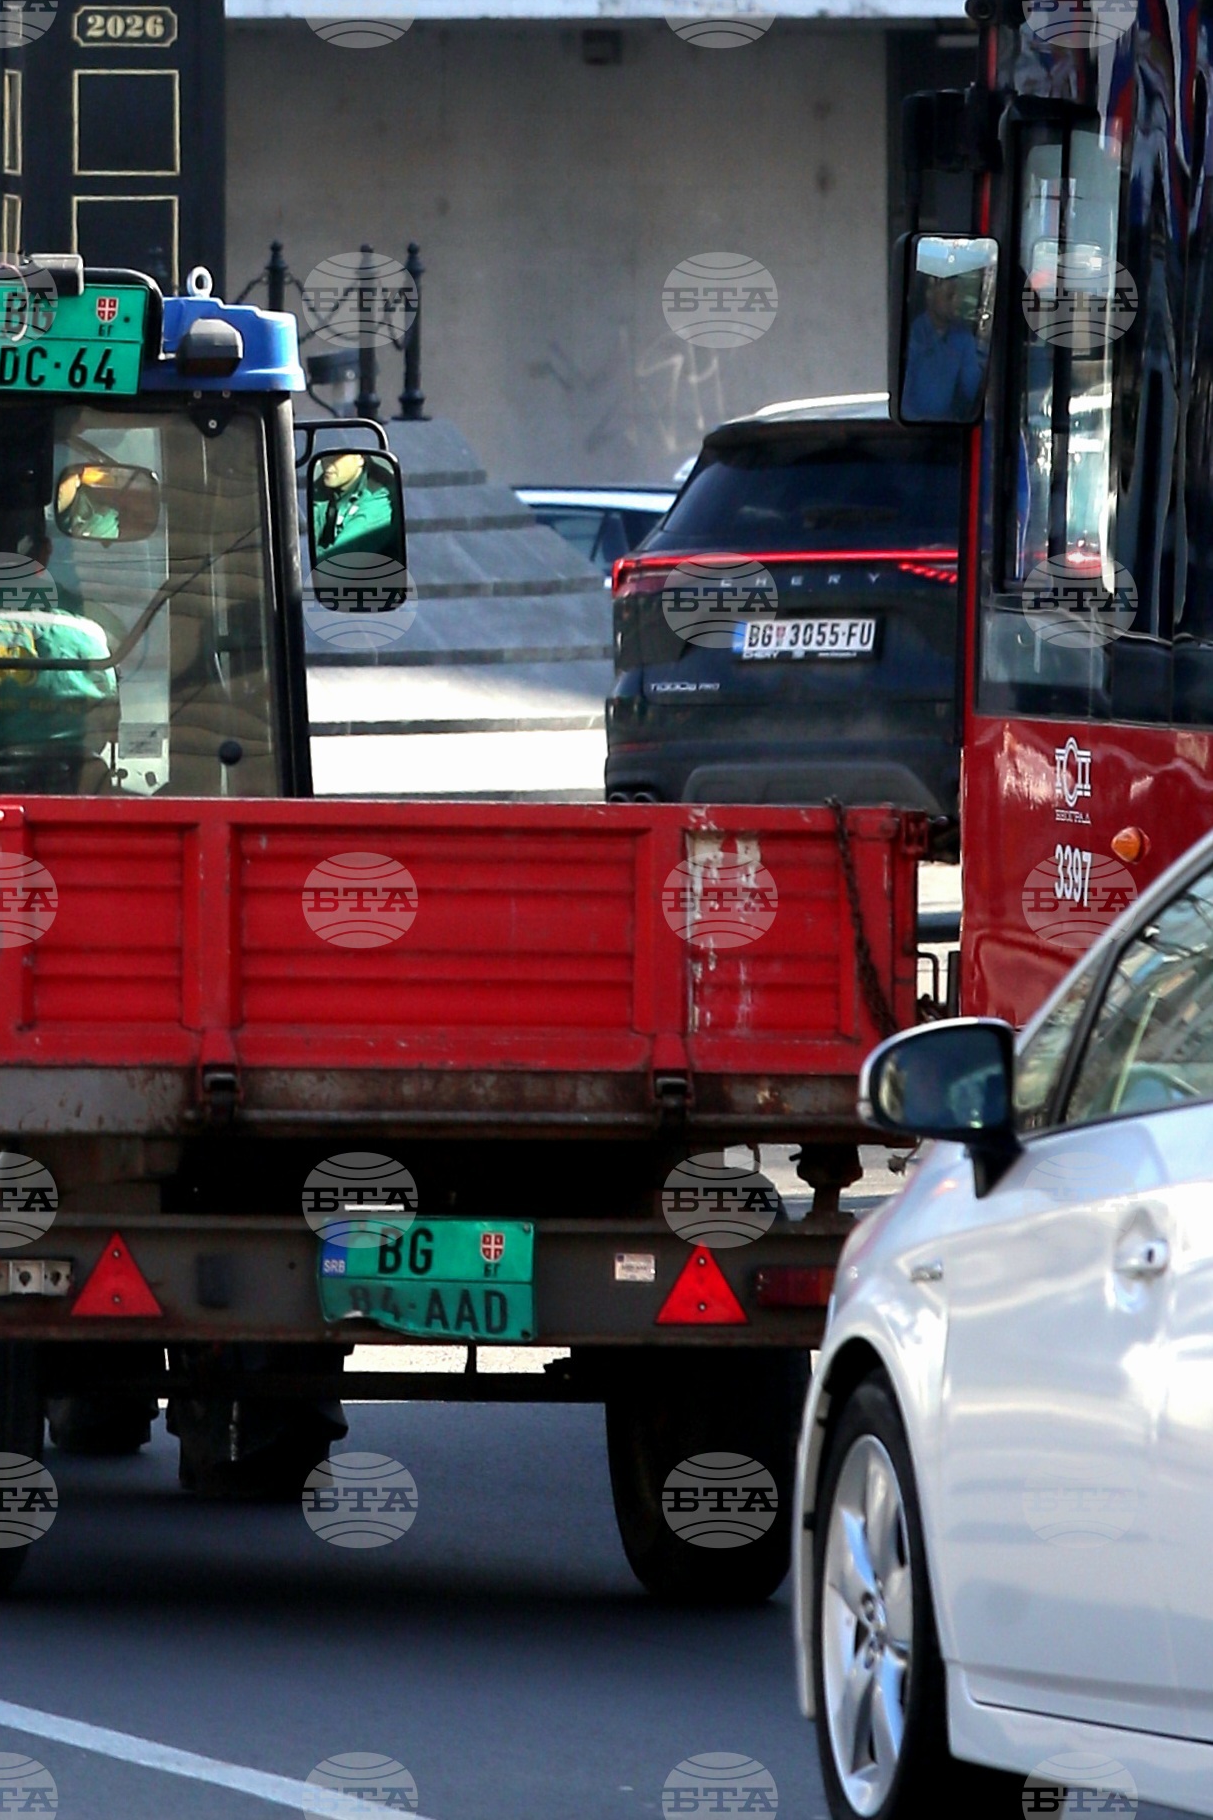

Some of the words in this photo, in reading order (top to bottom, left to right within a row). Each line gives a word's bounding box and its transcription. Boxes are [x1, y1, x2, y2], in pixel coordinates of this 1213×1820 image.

[86, 14, 165, 38] 2026
[4, 291, 54, 335] BG
[720, 573, 880, 588] CHERY
[1054, 844, 1092, 908] 3397
[323, 1259, 346, 1275] SRB
[377, 1226, 435, 1276] BG
